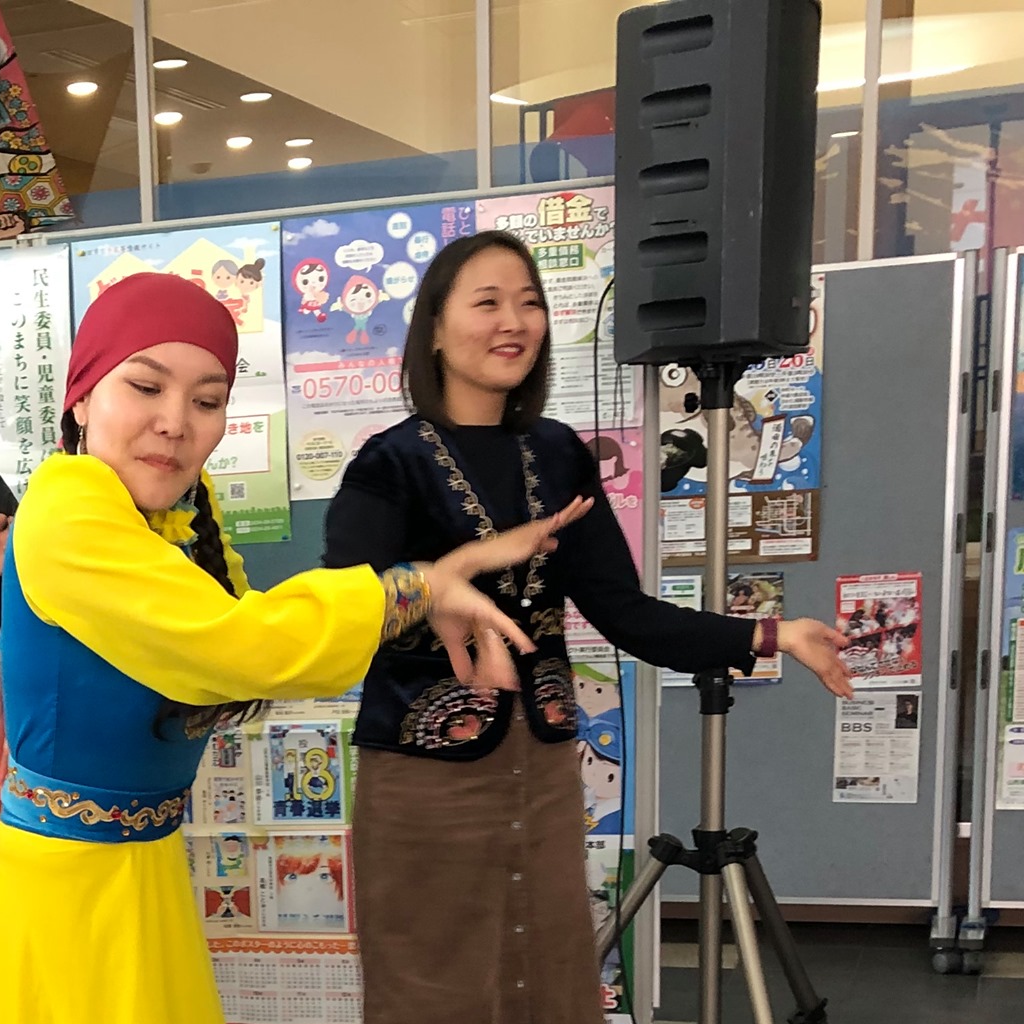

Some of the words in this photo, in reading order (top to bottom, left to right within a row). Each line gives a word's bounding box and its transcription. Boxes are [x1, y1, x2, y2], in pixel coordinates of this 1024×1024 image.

[512, 220, 615, 243] でいませんか
[303, 371, 402, 400] 0570-00
[224, 421, 264, 435] き地を
[841, 722, 873, 733] BBS
